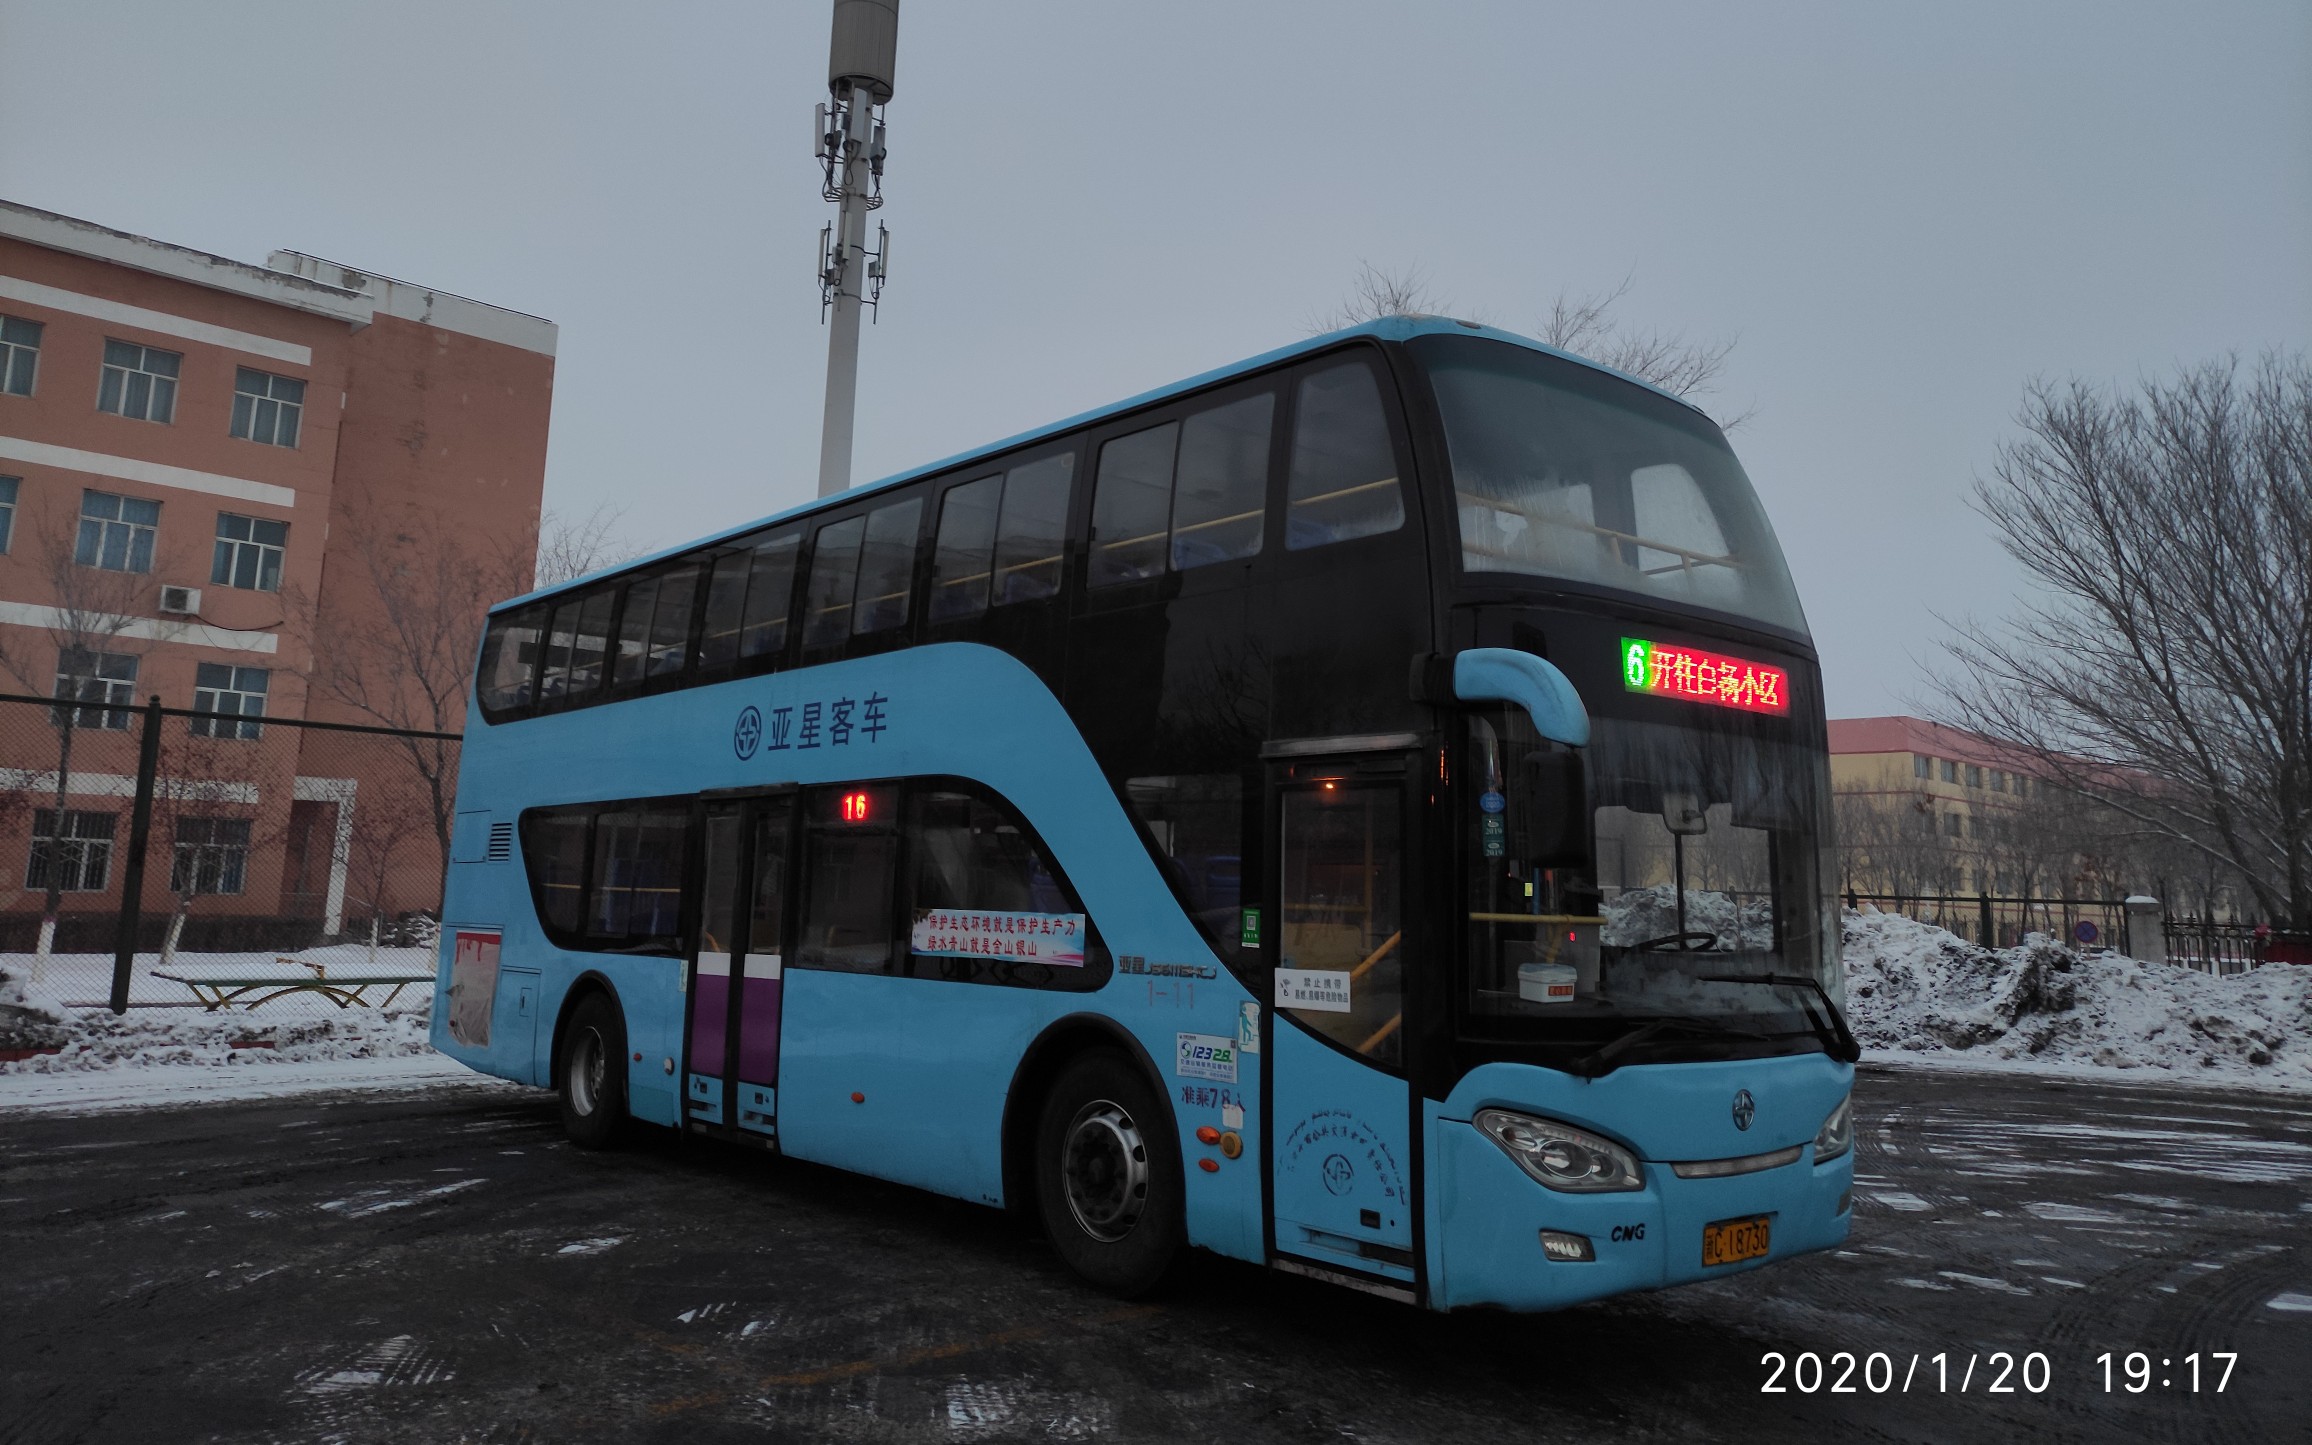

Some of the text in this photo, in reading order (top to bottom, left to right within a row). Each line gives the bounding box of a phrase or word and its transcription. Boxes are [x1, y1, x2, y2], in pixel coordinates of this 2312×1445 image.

[1626, 643, 1646, 687] 6
[767, 691, 889, 751] 亚星客车
[845, 794, 866, 820] 16
[928, 914, 1076, 936] 保护生态环境就是保护生产力
[927, 935, 1038, 957] 绿水青山就是金山银山
[1303, 976, 1342, 990] 禁止携带
[1192, 1045, 1233, 1063] 12328
[1611, 1223, 1645, 1241] CNG
